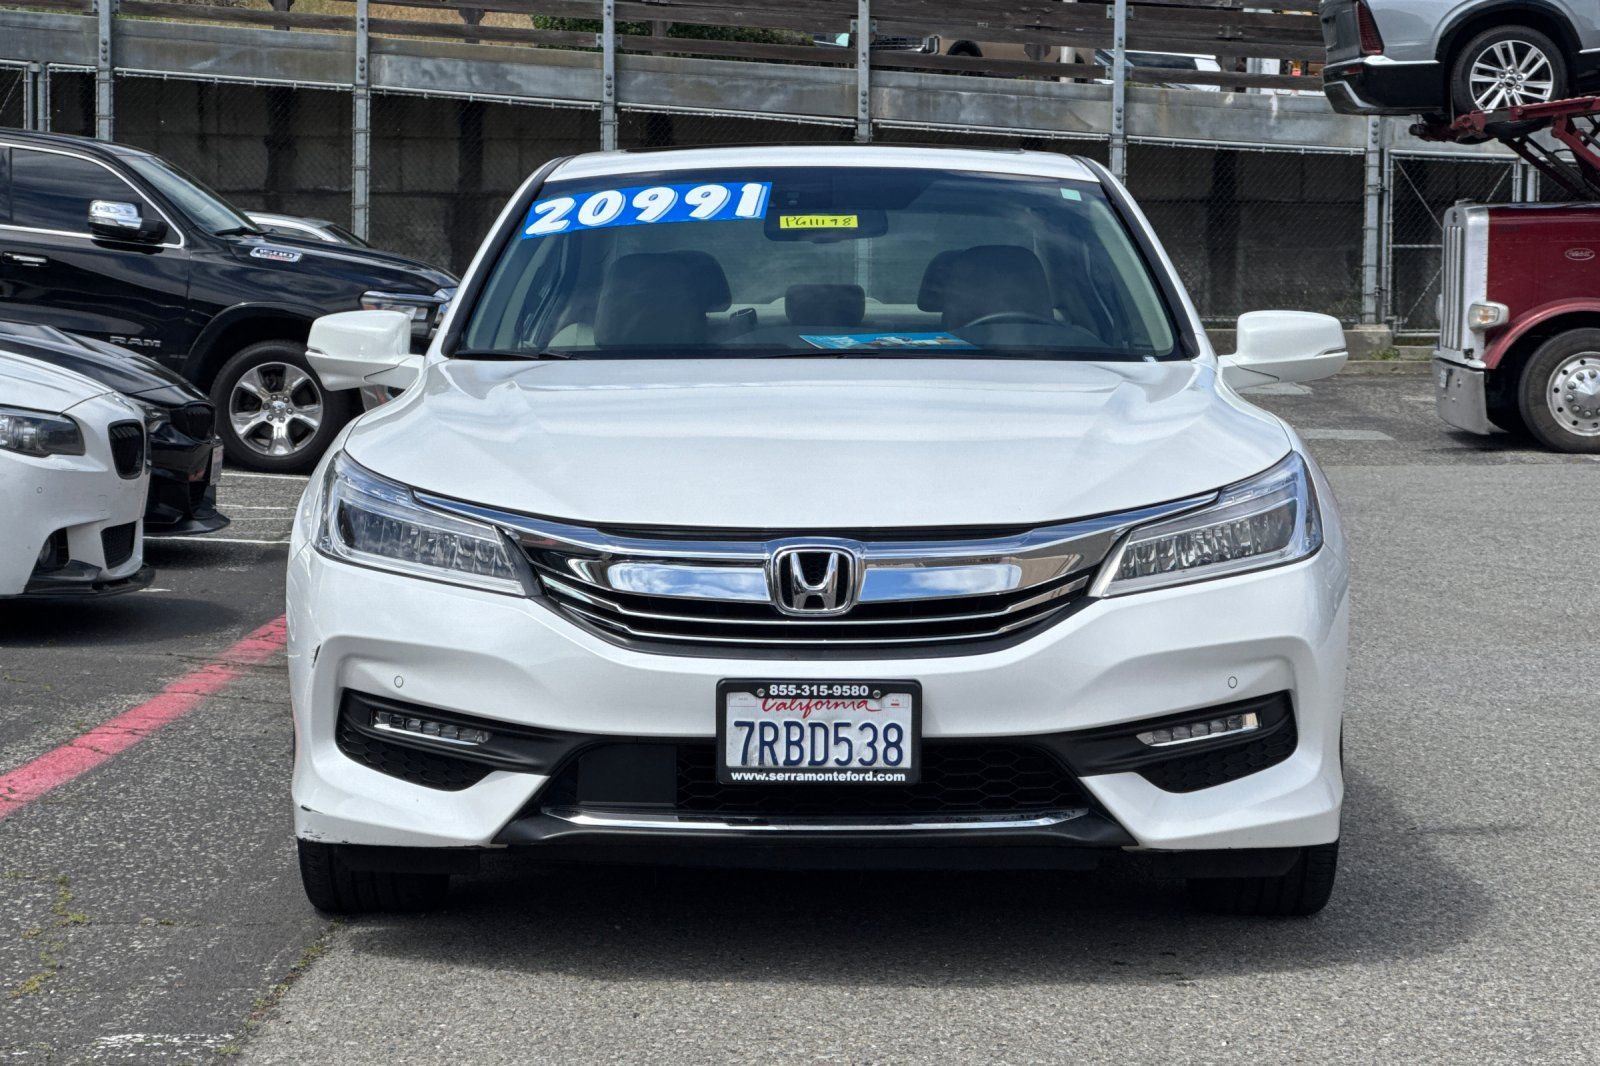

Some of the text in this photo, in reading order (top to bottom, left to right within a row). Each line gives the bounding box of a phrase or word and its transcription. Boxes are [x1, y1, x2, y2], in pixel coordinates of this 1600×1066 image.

[525, 183, 768, 235] 20991
[109, 335, 162, 348] RAM
[769, 684, 869, 697] 855-315-9580
[762, 697, 882, 719] California
[734, 720, 904, 766] 7RBD538
[731, 771, 906, 782] www.serramonteford.com
